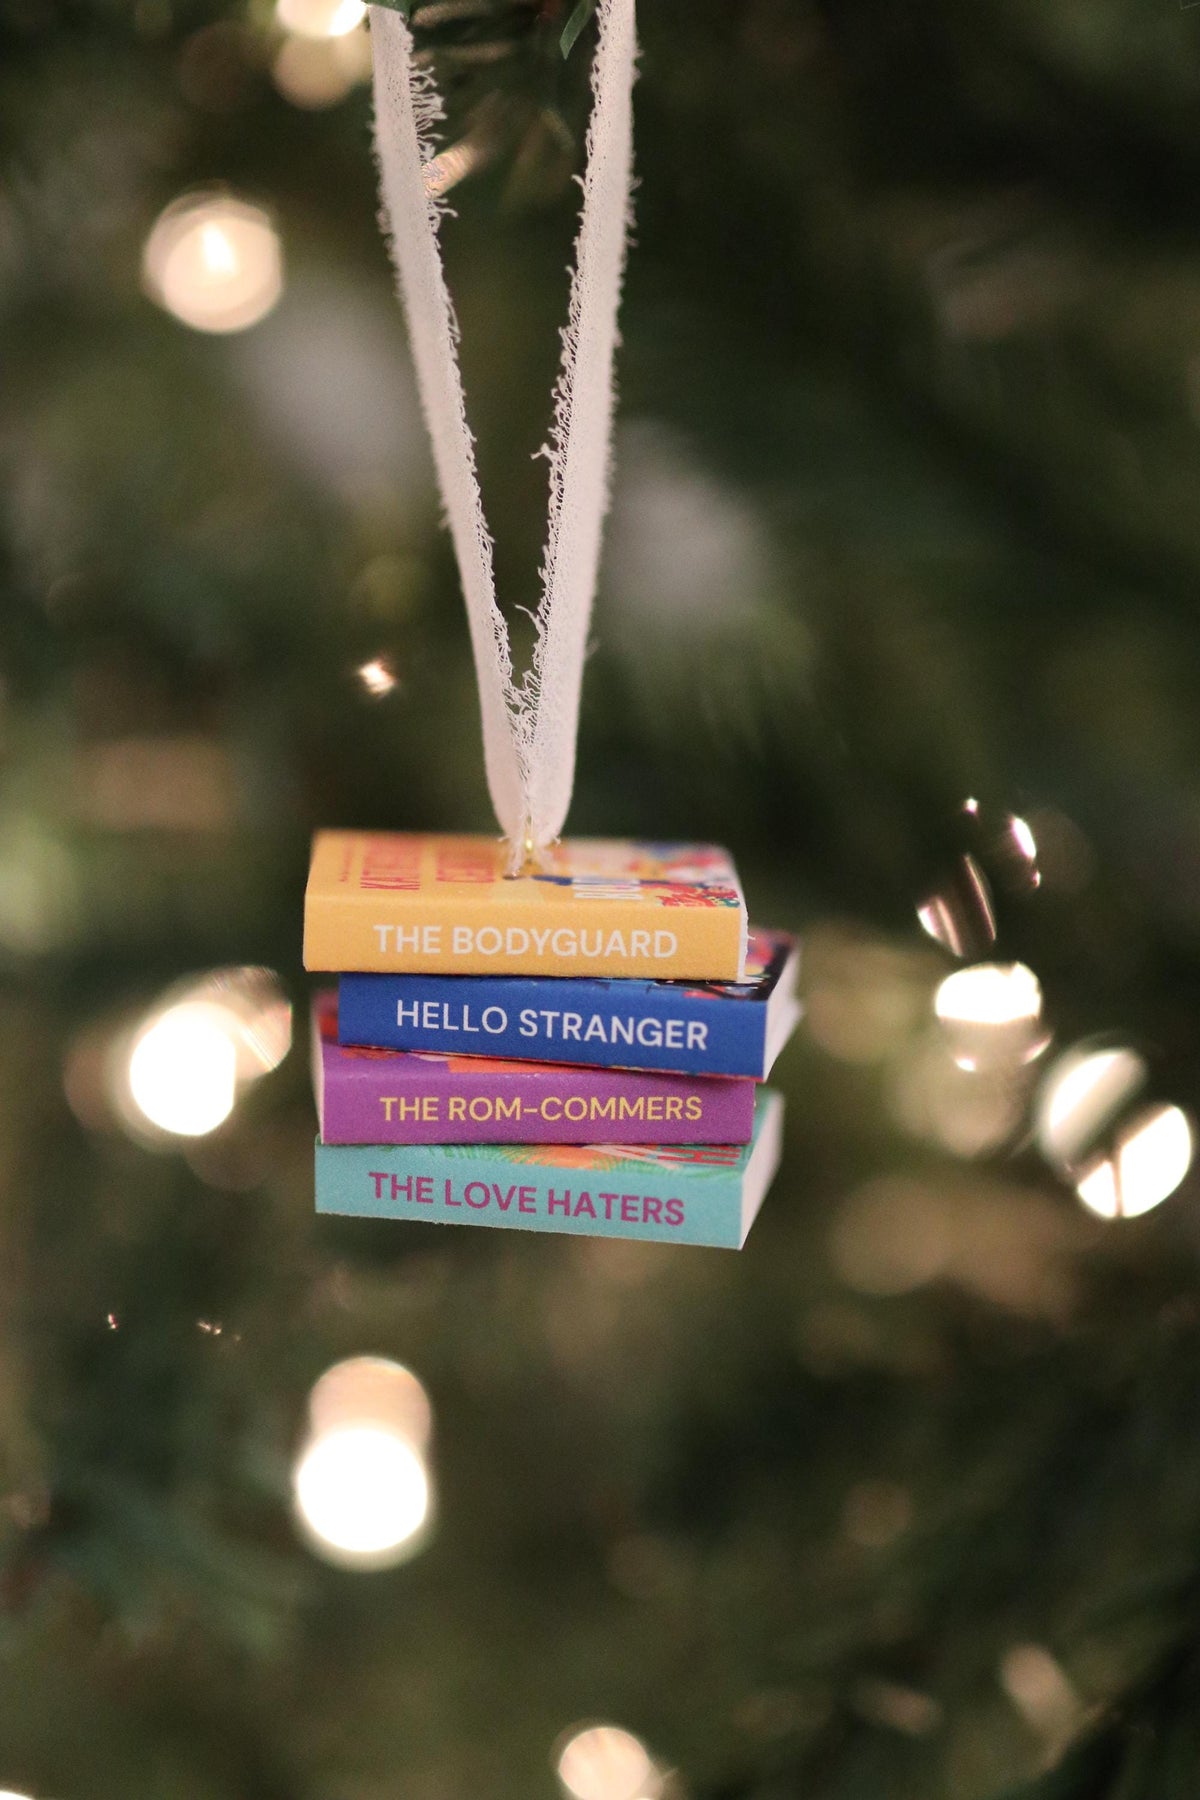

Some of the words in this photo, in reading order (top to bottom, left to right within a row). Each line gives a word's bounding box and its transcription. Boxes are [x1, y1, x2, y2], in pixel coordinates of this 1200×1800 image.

[373, 925, 441, 954] THE
[452, 927, 678, 959] BODYGUARD
[396, 999, 508, 1034] HELLO
[519, 1008, 709, 1051] STRANGER
[379, 1096, 440, 1121] THE
[448, 1096, 703, 1121] ROM-COMMERS
[368, 1171, 434, 1204] THE
[444, 1179, 537, 1214] LOVE
[547, 1189, 685, 1227] HATERS
